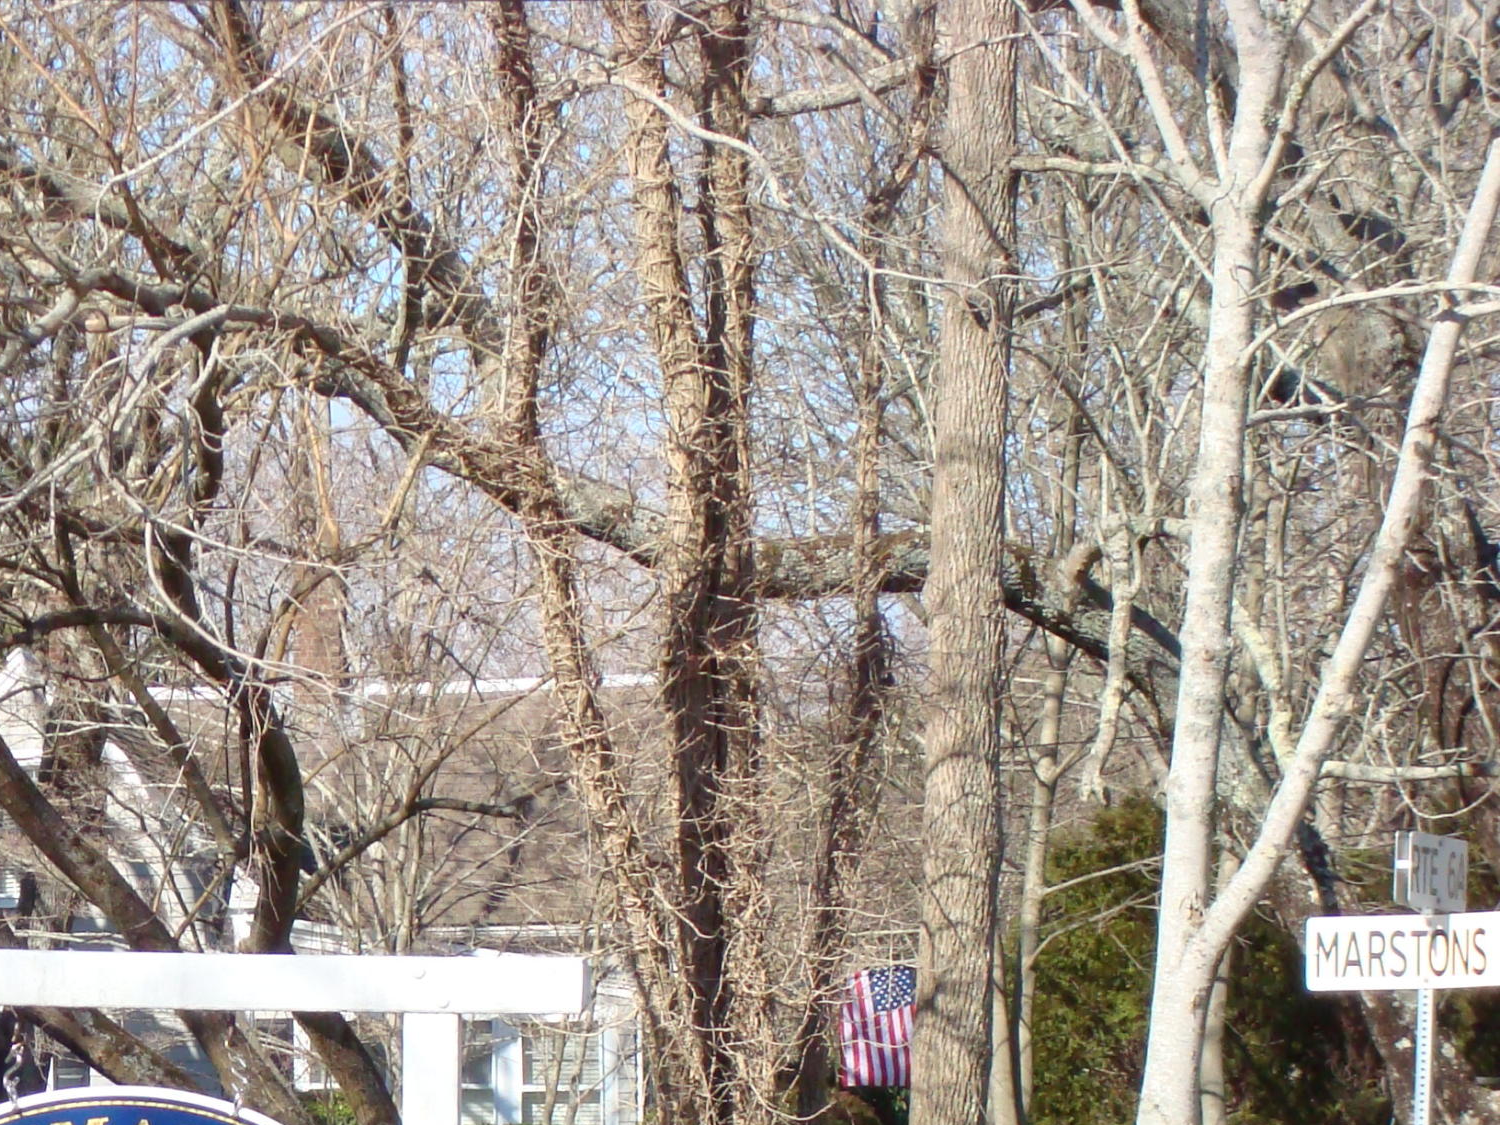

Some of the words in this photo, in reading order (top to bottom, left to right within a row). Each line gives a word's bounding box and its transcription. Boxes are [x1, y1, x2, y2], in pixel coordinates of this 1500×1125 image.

[1411, 845, 1439, 896] RTE
[1447, 851, 1465, 900] 6A
[1315, 927, 1487, 978] MARSTONS
